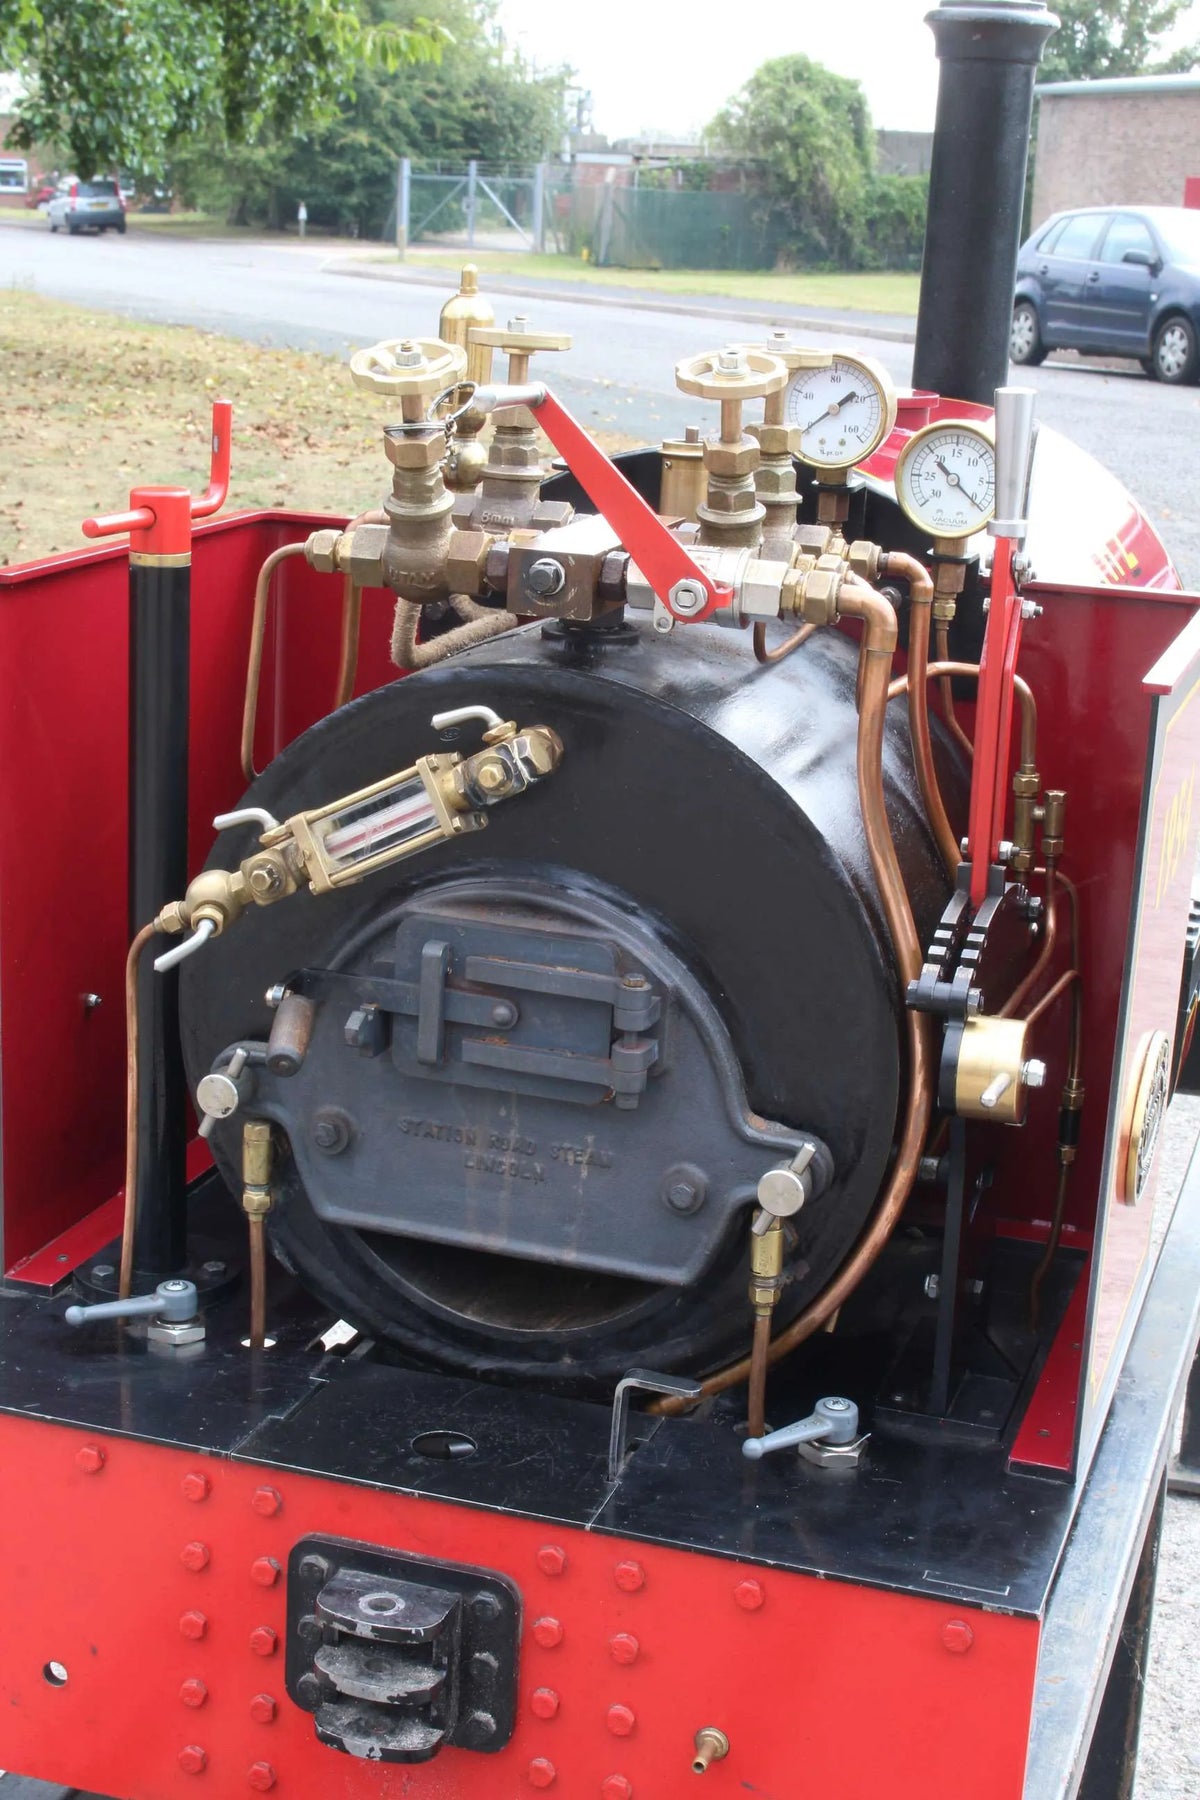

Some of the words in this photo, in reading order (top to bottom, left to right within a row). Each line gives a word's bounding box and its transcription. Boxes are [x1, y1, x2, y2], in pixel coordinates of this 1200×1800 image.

[830, 375, 841, 384] 80
[803, 392, 814, 400] 40
[843, 424, 859, 433] 160
[951, 448, 963, 458] 15
[933, 454, 946, 464] 20
[967, 457, 978, 467] 10
[924, 471, 936, 481] 25
[978, 477, 984, 486] 5
[930, 489, 941, 498] 30
[971, 491, 977, 501] 0
[932, 516, 968, 525] VACUUM
[398, 1116, 477, 1146] STATION
[489, 1131, 537, 1156] ROAD
